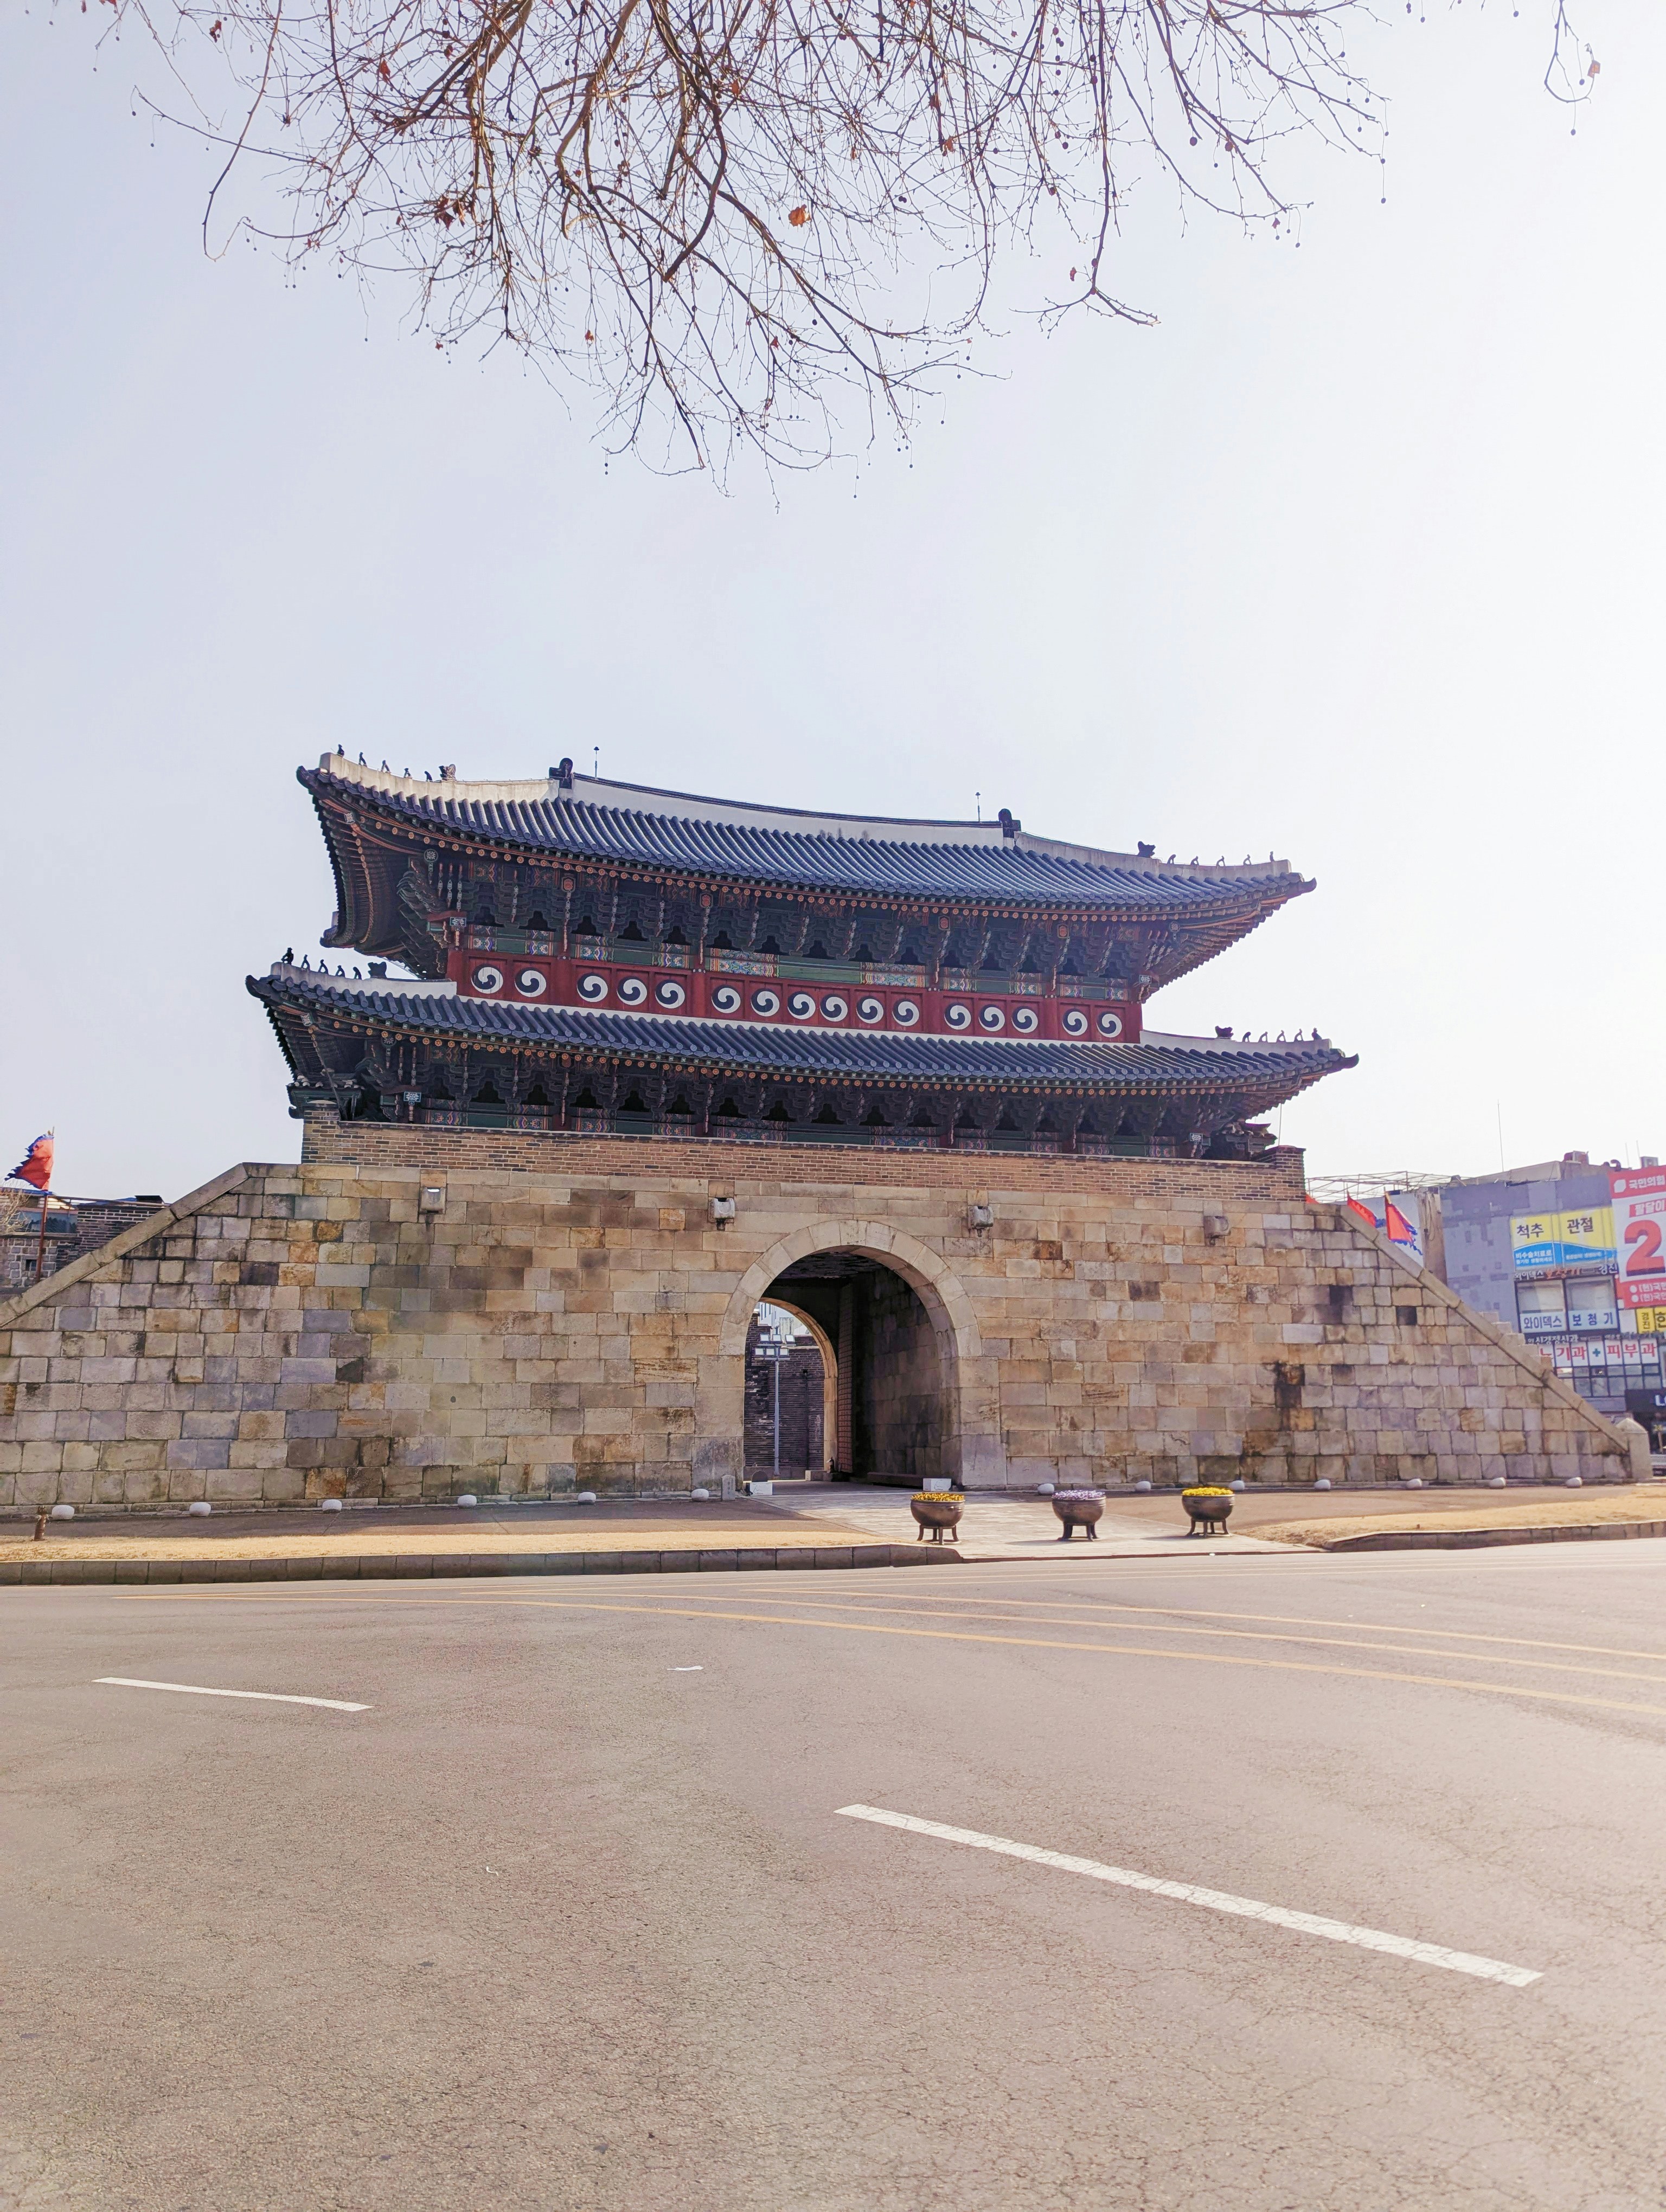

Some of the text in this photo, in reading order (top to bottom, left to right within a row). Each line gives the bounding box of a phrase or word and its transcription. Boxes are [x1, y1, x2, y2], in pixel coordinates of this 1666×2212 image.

[1629, 1175, 1665, 1189] 국민의힘
[1517, 1217, 1594, 1239] 척추 관절
[1625, 1220, 1665, 1276] 2
[1524, 1315, 1562, 1329] 와이덱스
[1536, 1334, 1578, 1345] 신경정신과
[1607, 1343, 1657, 1359] 피부과
